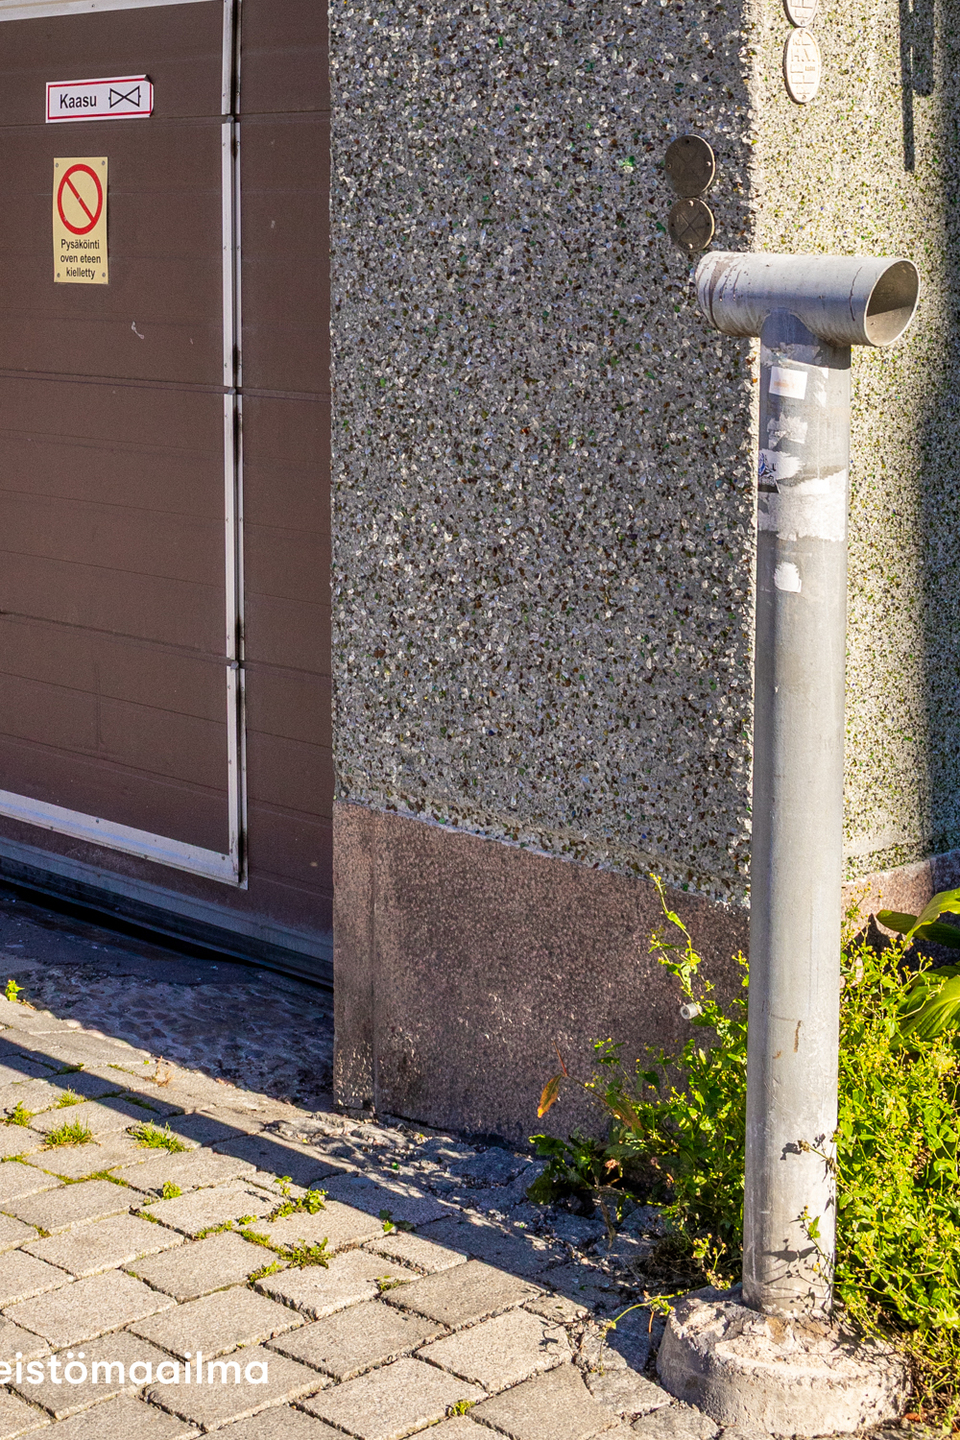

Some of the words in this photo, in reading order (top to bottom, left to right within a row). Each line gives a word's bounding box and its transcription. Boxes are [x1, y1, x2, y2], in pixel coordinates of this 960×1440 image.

[59, 93, 97, 109] Kaasu
[60, 238, 100, 251] Pysäköinti
[80, 255, 101, 263] eteen
[66, 267, 96, 280] kielletty
